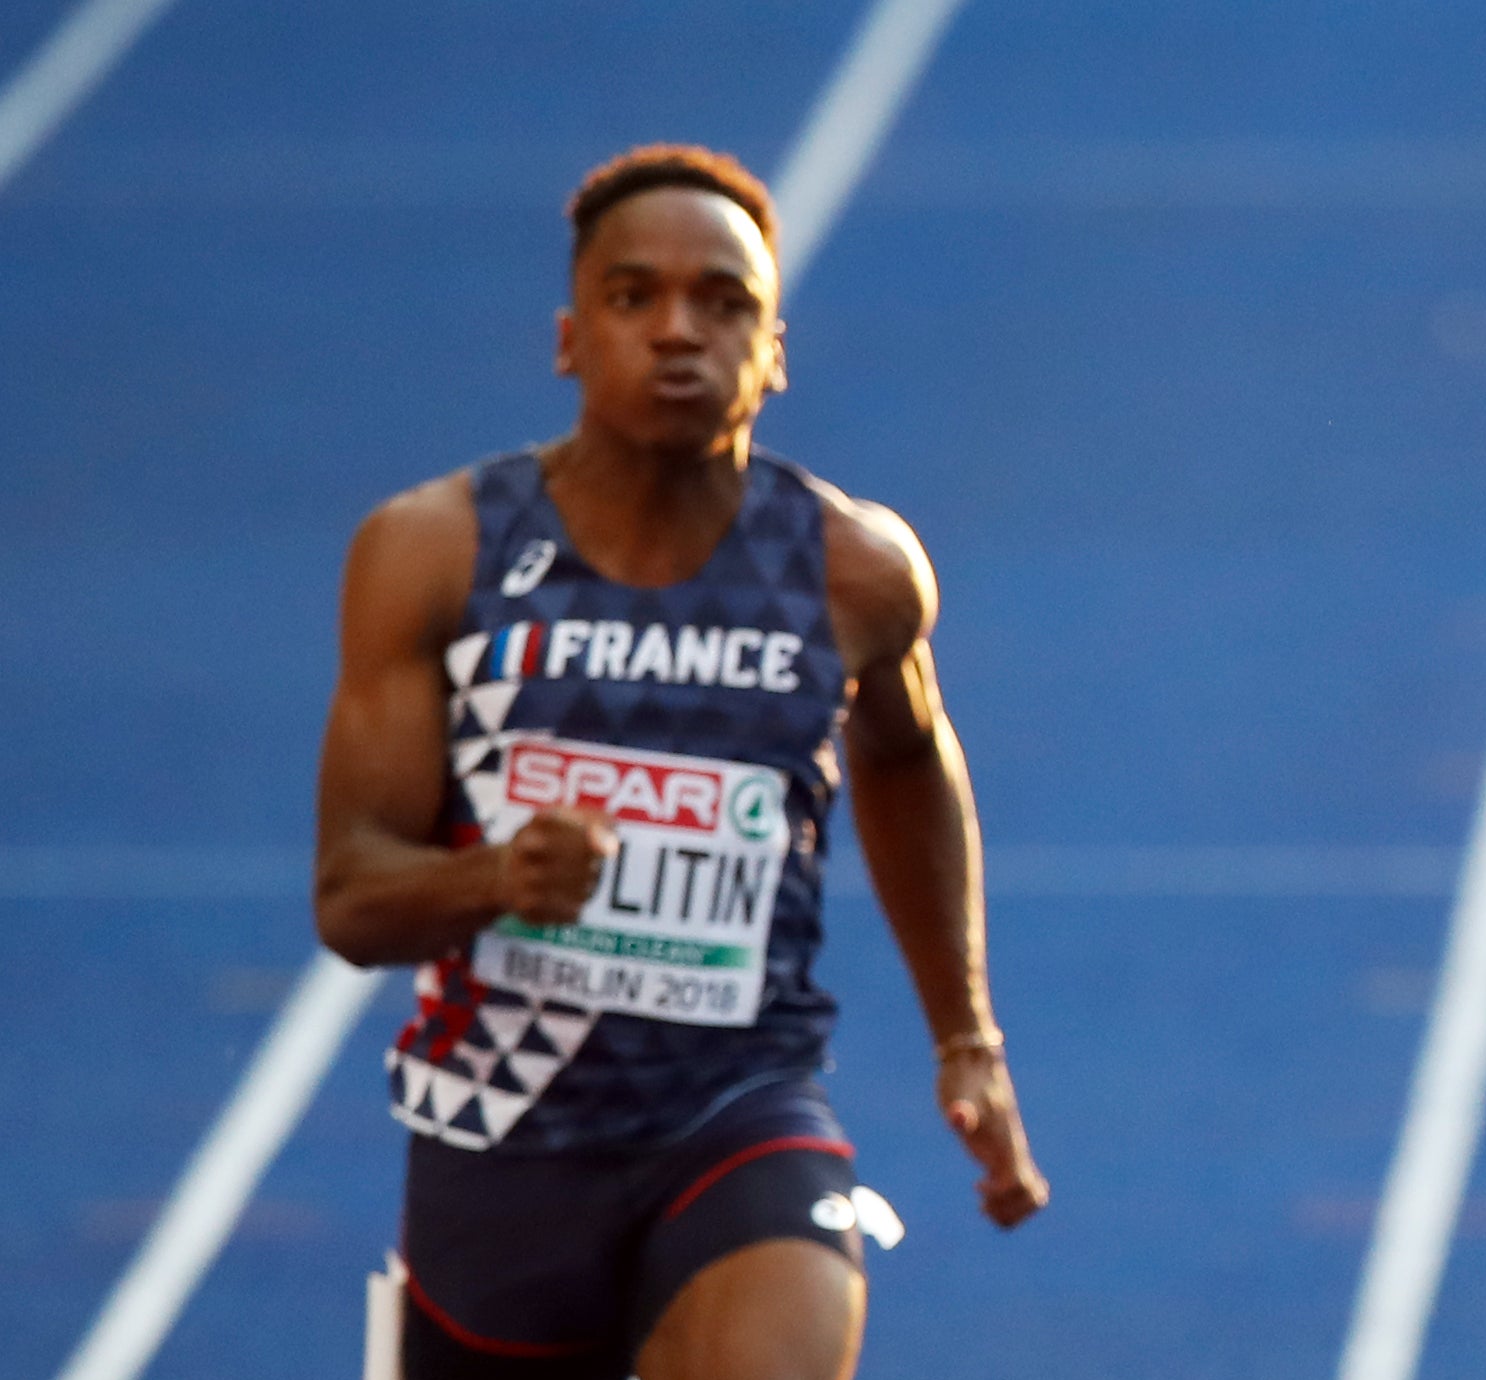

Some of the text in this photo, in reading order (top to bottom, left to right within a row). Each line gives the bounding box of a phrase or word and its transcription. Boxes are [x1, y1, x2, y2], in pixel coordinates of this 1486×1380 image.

[546, 619, 803, 692] FRANCE
[513, 755, 720, 823] SPAR
[608, 839, 767, 925] LITIN
[504, 944, 741, 1014] BERLIN 2018
